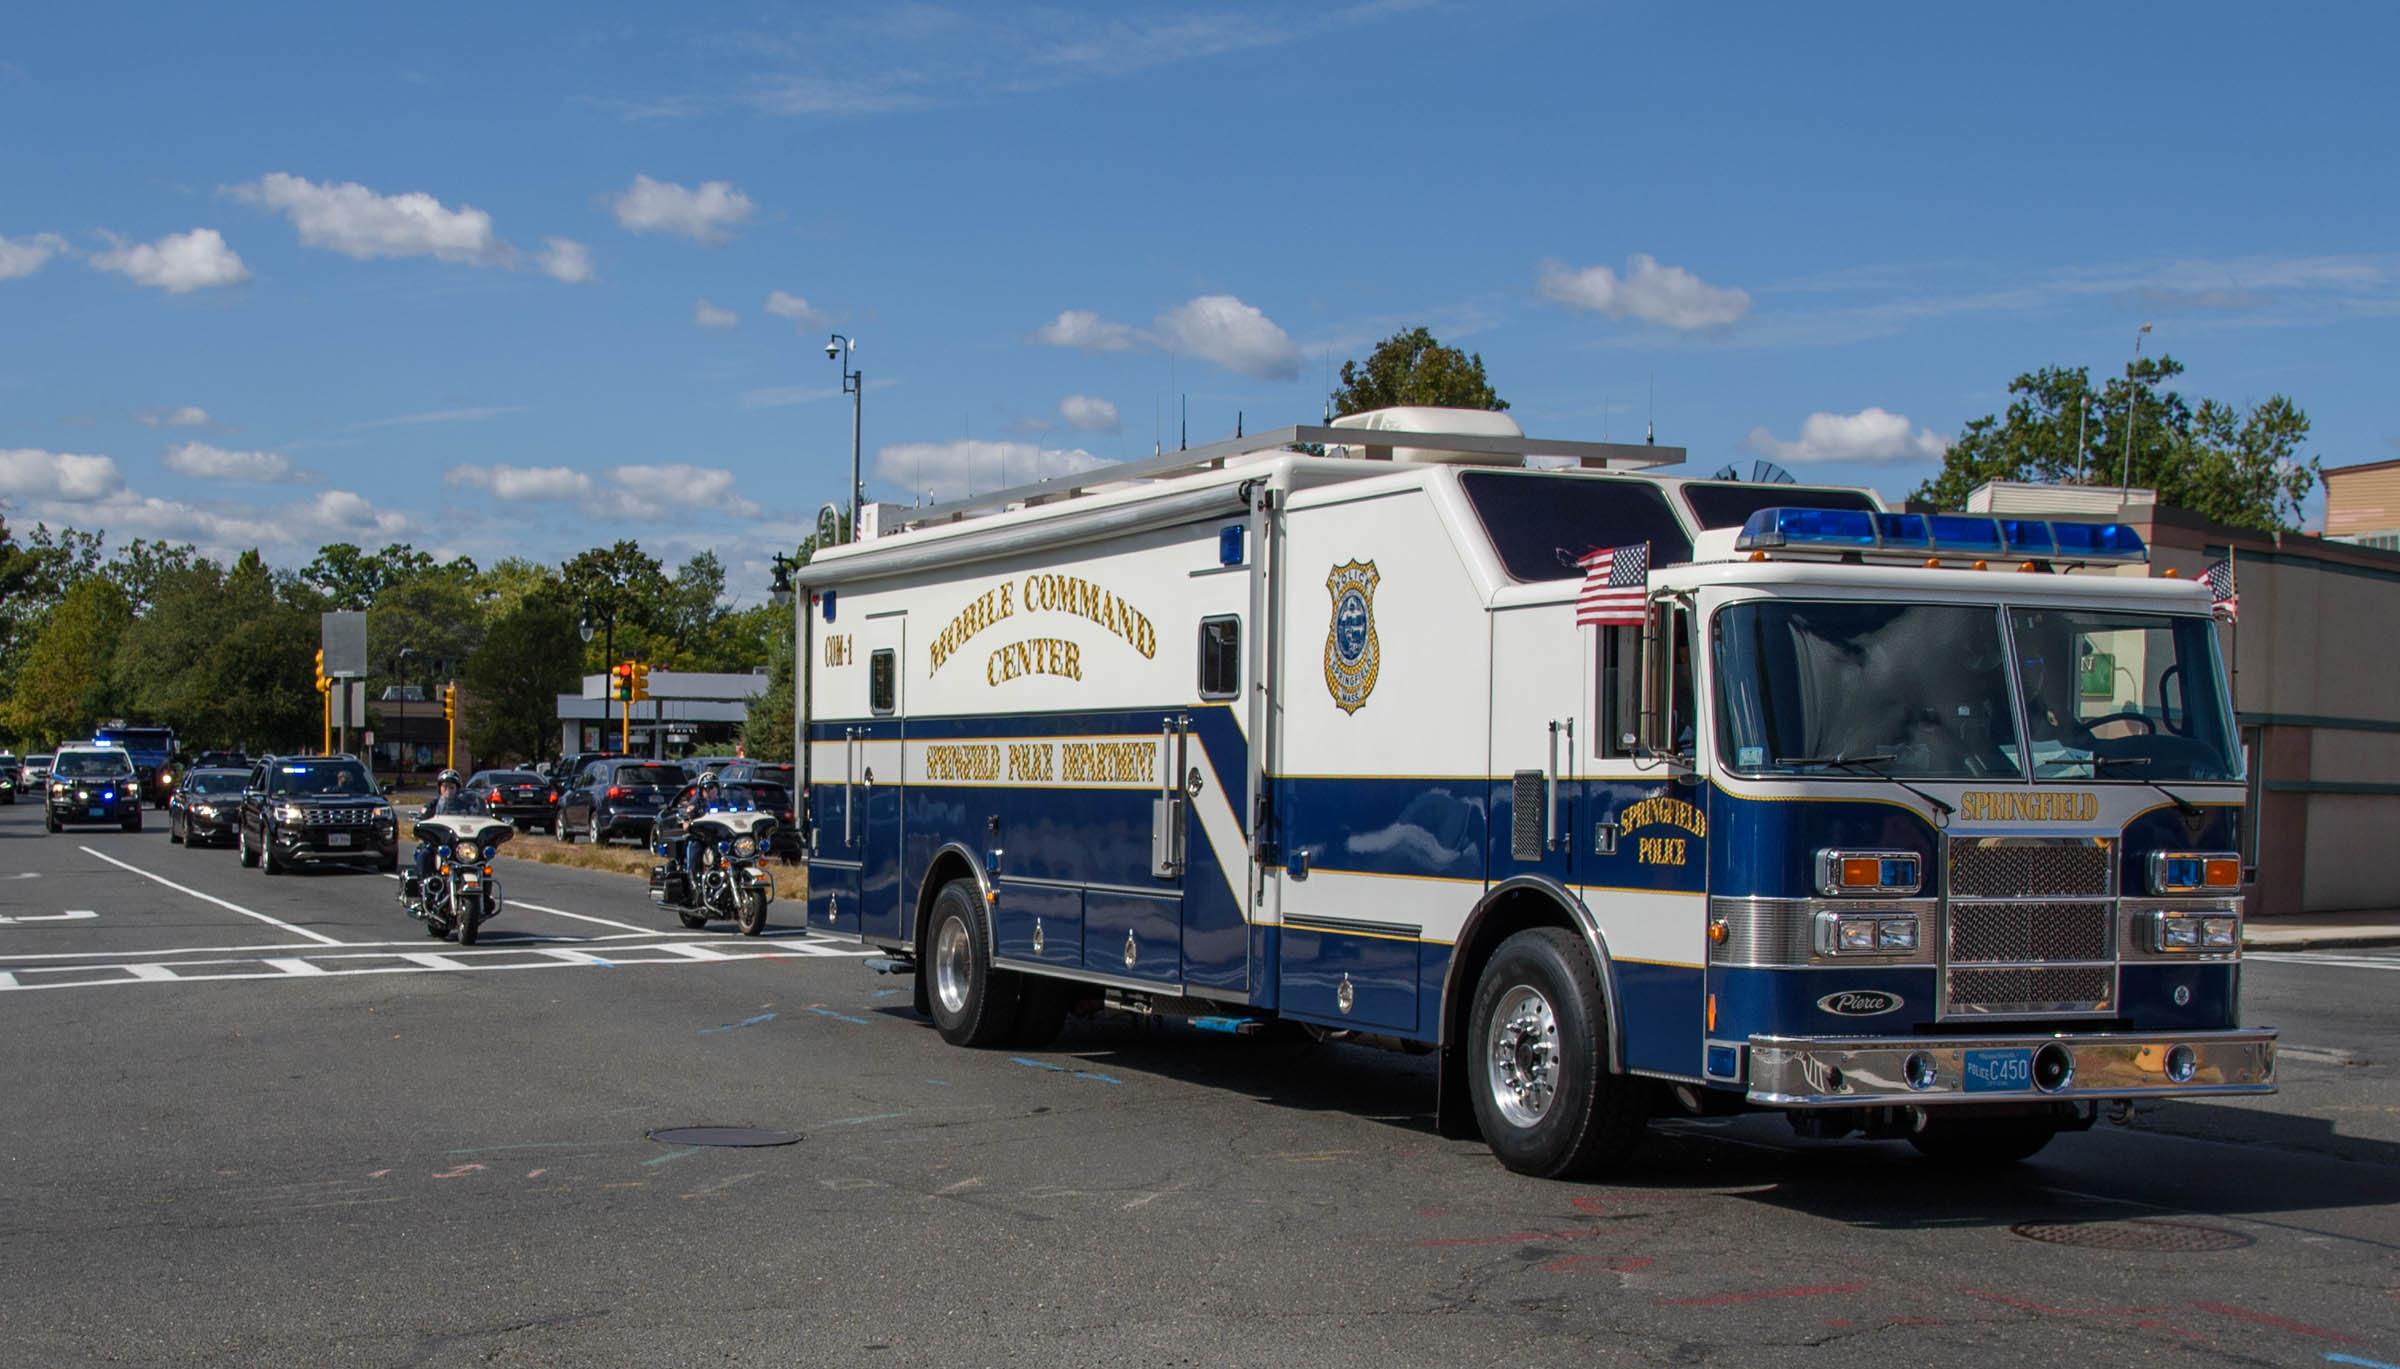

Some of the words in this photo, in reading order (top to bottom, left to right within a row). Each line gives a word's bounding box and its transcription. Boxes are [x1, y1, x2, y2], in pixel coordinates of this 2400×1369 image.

[1335, 568, 1371, 592] POLICE
[929, 580, 1015, 680] MOBILE
[1023, 573, 1157, 660] COMMAND
[824, 633, 853, 668] COM-1
[986, 637, 1083, 688] CENTER
[1331, 657, 1373, 687] SPRINGFIELD
[926, 744, 1000, 781] SPRINGFIELD
[1008, 743, 1054, 782] POLICE
[1062, 742, 1157, 783] DEPARTMENT
[1620, 797, 1706, 838] SPRINGFIELD
[1961, 791, 2099, 821] SPRINGFIELD
[1638, 837, 1687, 866] POLICE
[1836, 993, 1885, 1012] Pierce
[1967, 1062, 1990, 1081] POLICE
[1990, 1059, 2028, 1081] C450
